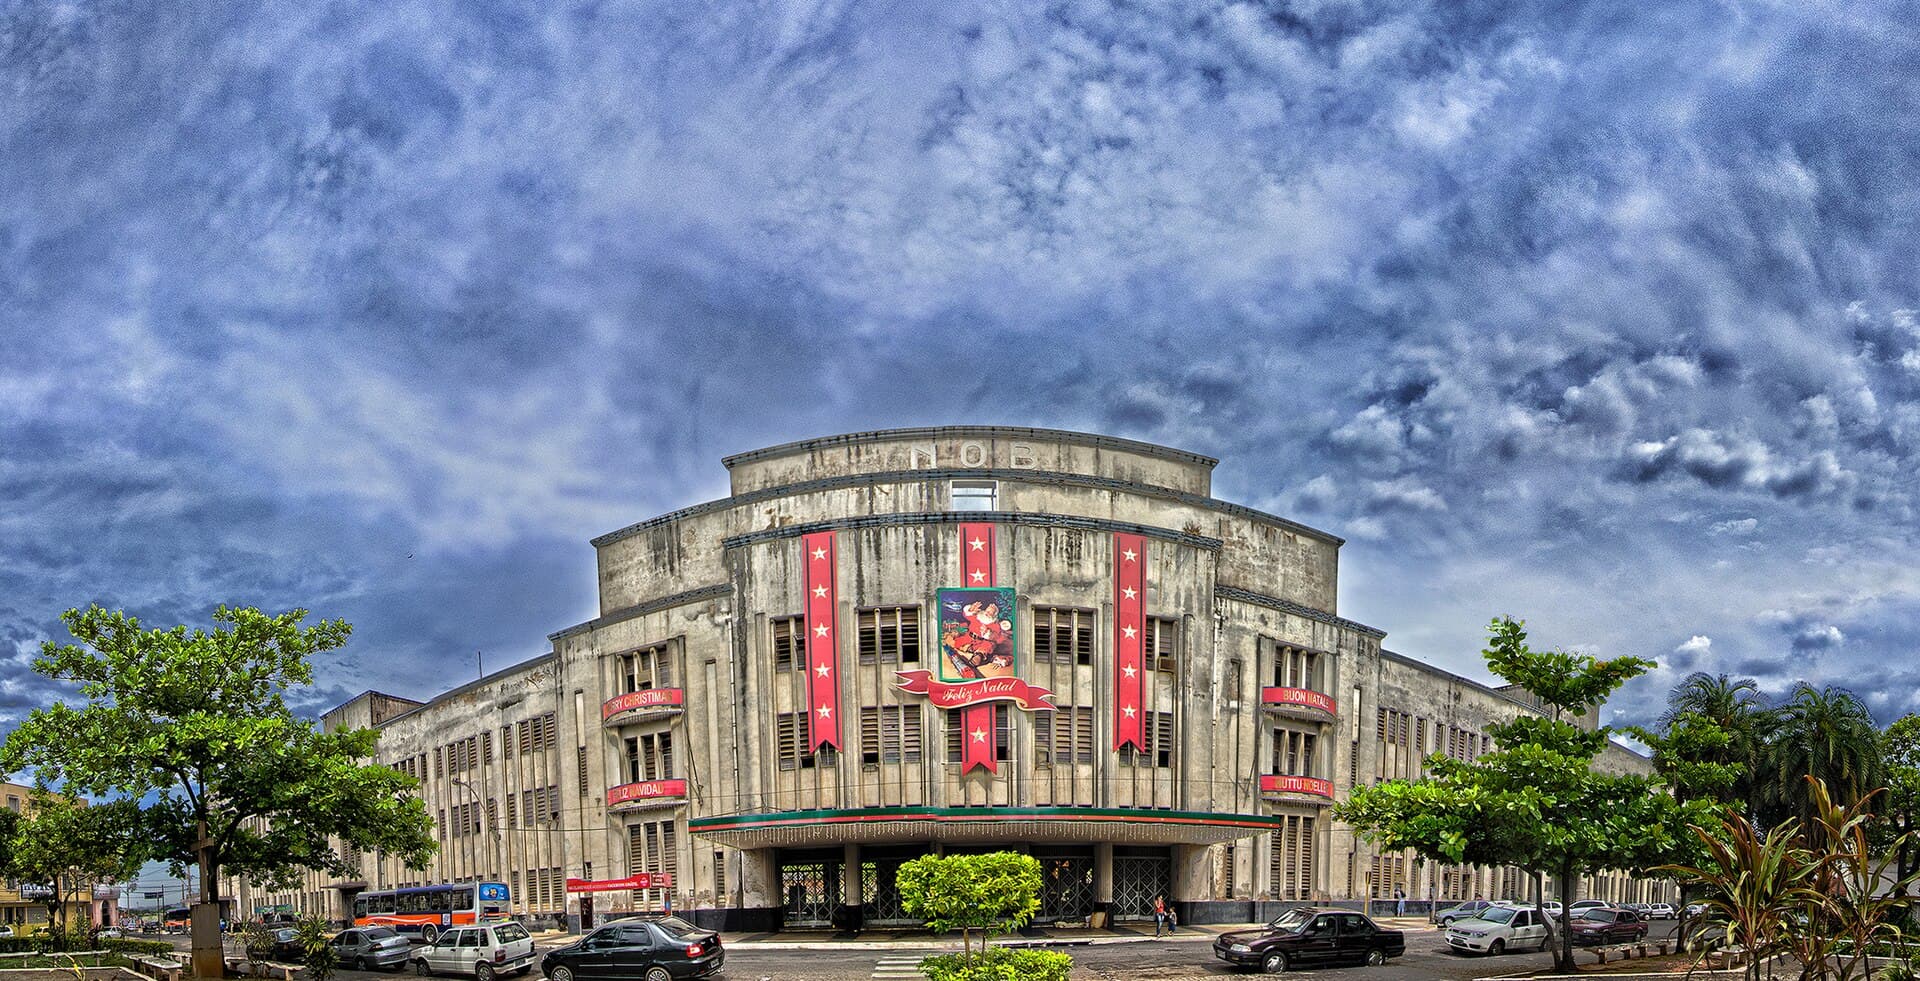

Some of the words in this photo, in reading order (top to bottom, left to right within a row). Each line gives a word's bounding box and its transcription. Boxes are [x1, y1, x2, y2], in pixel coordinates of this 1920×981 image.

[942, 686, 973, 702] Feliz
[975, 679, 1018, 695] Natal
[1283, 689, 1306, 702] BUON
[613, 787, 629, 800] LIZ
